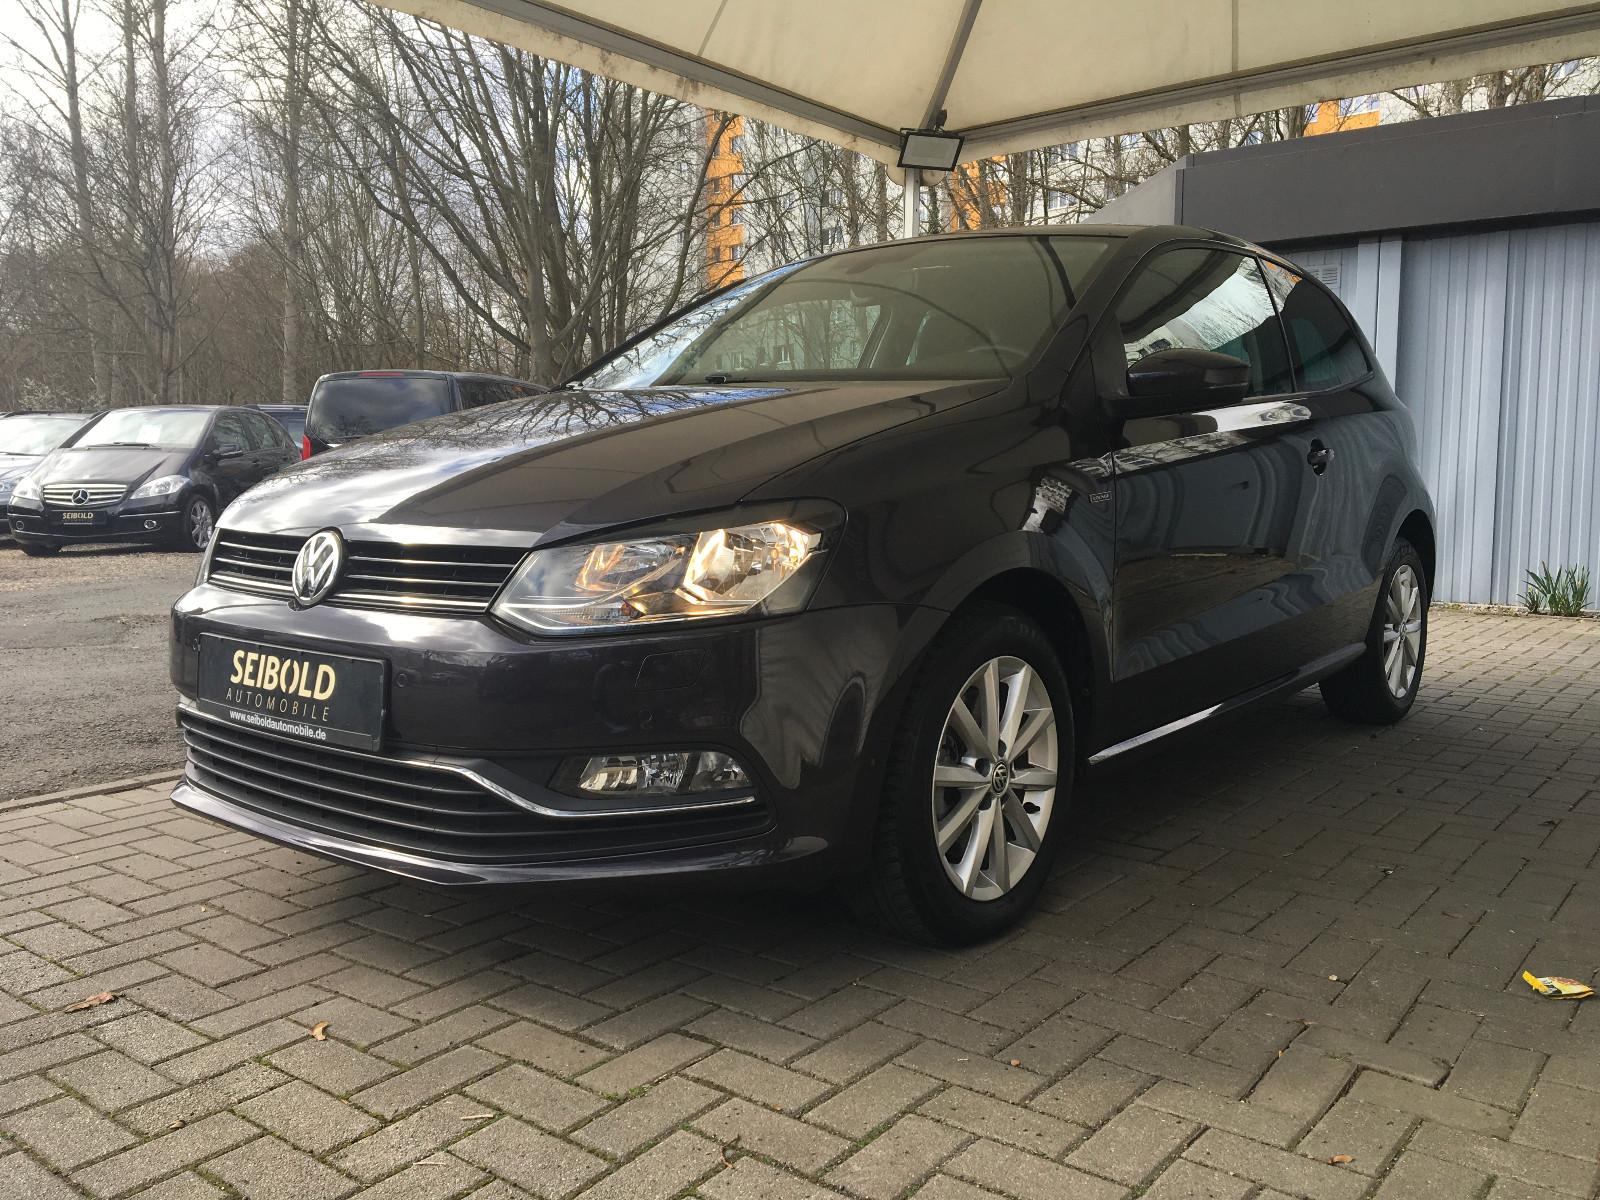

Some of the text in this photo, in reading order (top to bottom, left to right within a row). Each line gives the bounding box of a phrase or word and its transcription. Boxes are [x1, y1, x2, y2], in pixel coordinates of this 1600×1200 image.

[62, 512, 94, 520] SEIBOLD
[294, 531, 340, 601] VW
[230, 649, 336, 701] SEIBOLD
[226, 687, 330, 722] AUTOMOBILE
[229, 709, 327, 741] www.seiboldautomobile.de
